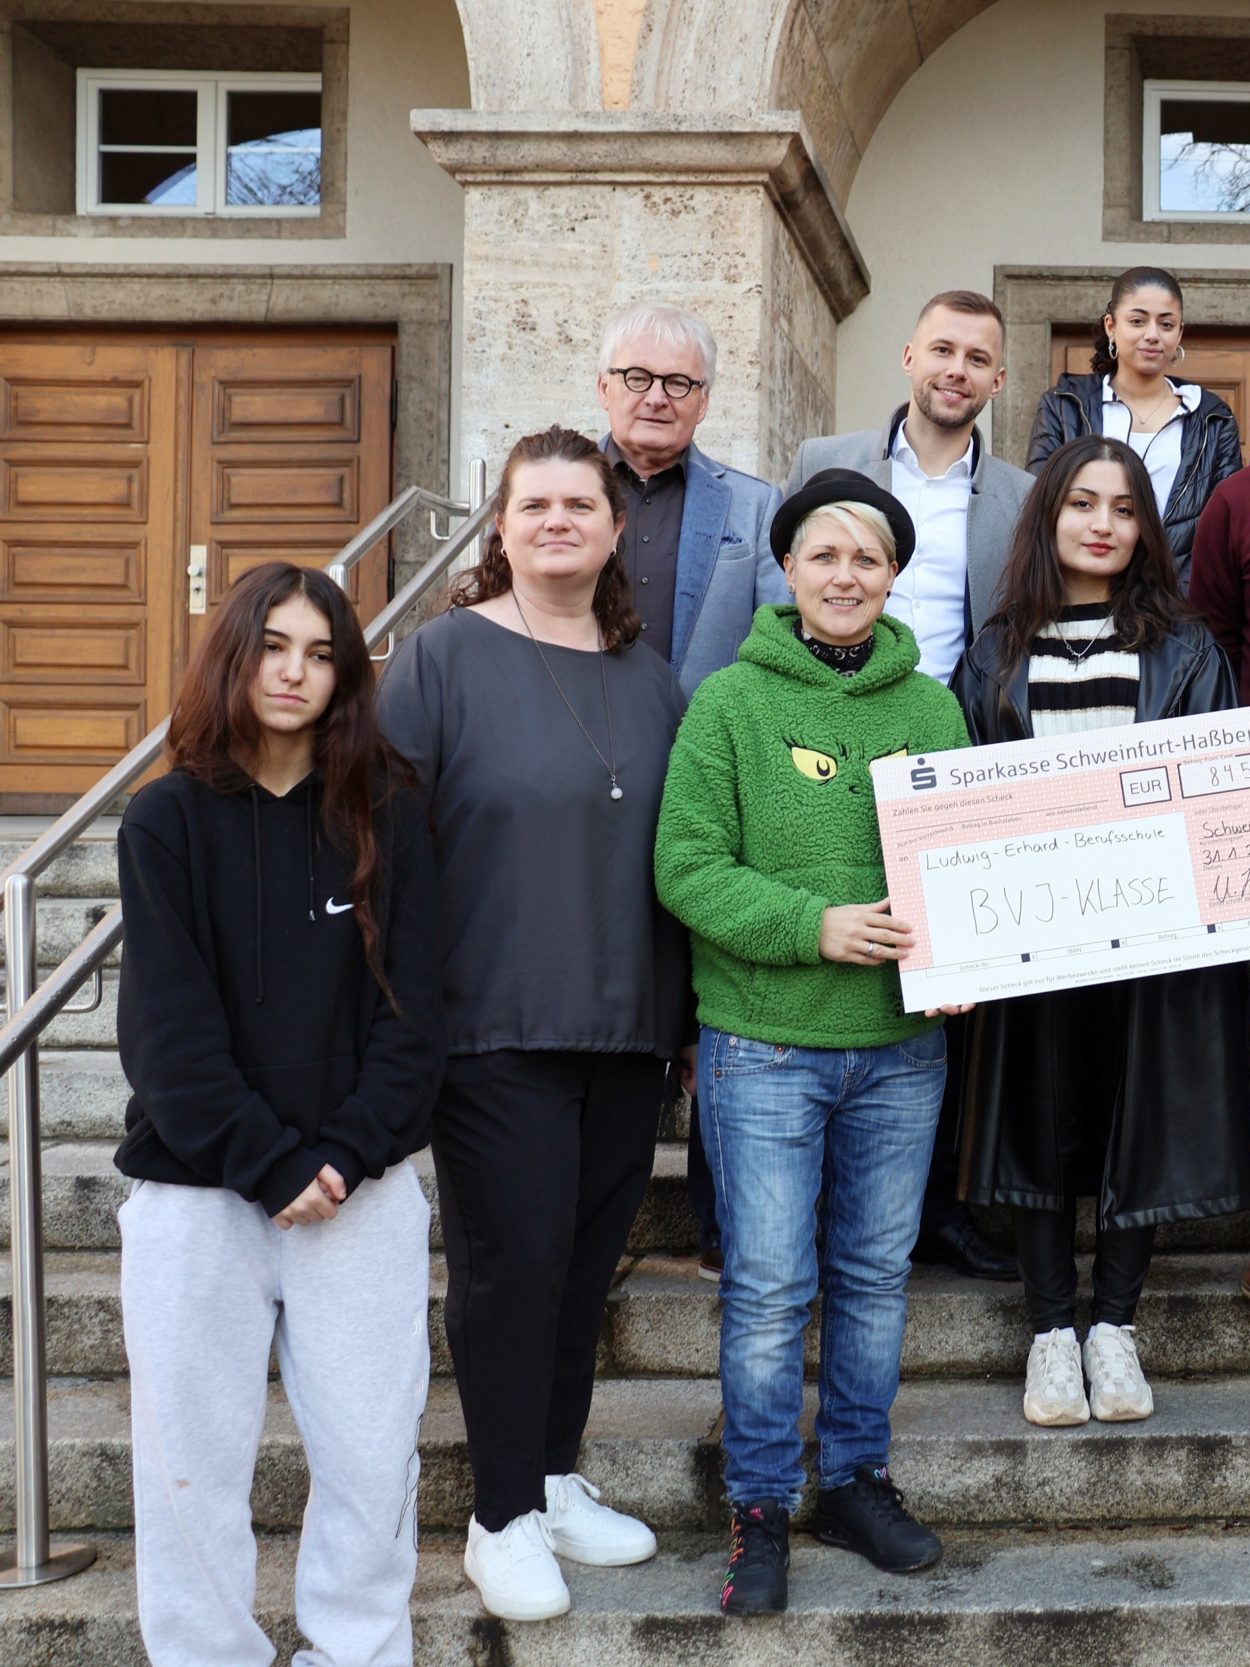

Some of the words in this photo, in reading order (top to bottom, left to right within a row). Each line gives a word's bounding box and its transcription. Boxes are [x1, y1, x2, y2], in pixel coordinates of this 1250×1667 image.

[950, 760, 1051, 788] Sparkasse
[1129, 779, 1162, 795] EUR
[893, 807, 919, 817] Zahlen
[920, 805, 932, 813] Sie
[934, 802, 959, 812] gegen
[960, 798, 985, 807] diesen
[986, 793, 1014, 803] Scheck
[1000, 981, 1022, 990] Scheck
[1150, 957, 1172, 967] Scheck
[1201, 950, 1213, 958] des
